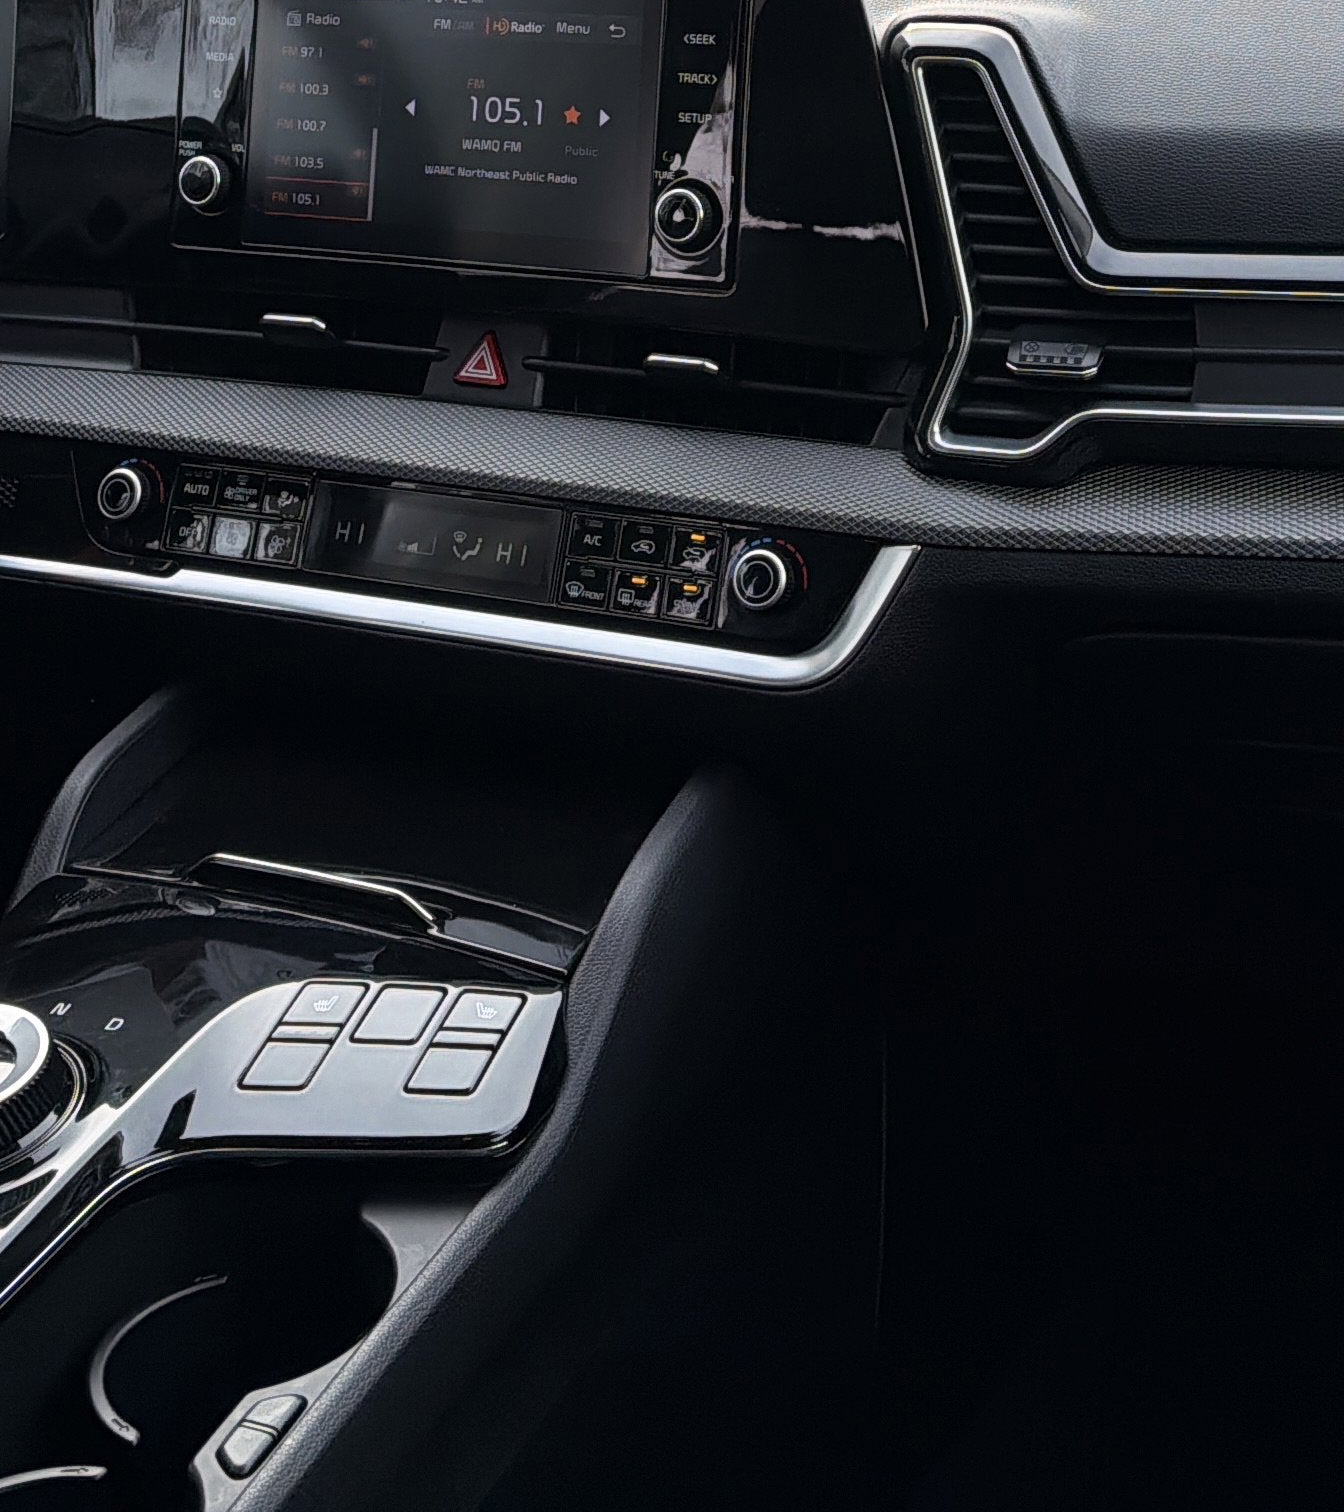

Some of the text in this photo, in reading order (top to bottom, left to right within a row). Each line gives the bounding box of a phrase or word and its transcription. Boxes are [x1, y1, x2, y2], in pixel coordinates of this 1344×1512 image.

[208, 16, 236, 26] RADIO
[306, 13, 341, 27] Radio
[556, 22, 591, 35] Menu
[206, 51, 235, 62] MEDIA
[300, 83, 329, 95] 100.3
[470, 95, 544, 127] 105.1
[678, 112, 713, 124] SETUP
[297, 119, 327, 132] 100.7
[503, 140, 522, 153] FM
[565, 145, 599, 157] Public
[294, 156, 325, 169] 103.5
[457, 166, 510, 181] Northeast
[512, 170, 546, 183] Public
[547, 172, 578, 185] Radio
[271, 192, 321, 205] FM 105.1
[184, 482, 210, 496] AUTO
[583, 534, 602, 547] A/C
[581, 591, 605, 600] FRONT
[50, 1002, 72, 1015] N
[104, 1017, 125, 1031] D
